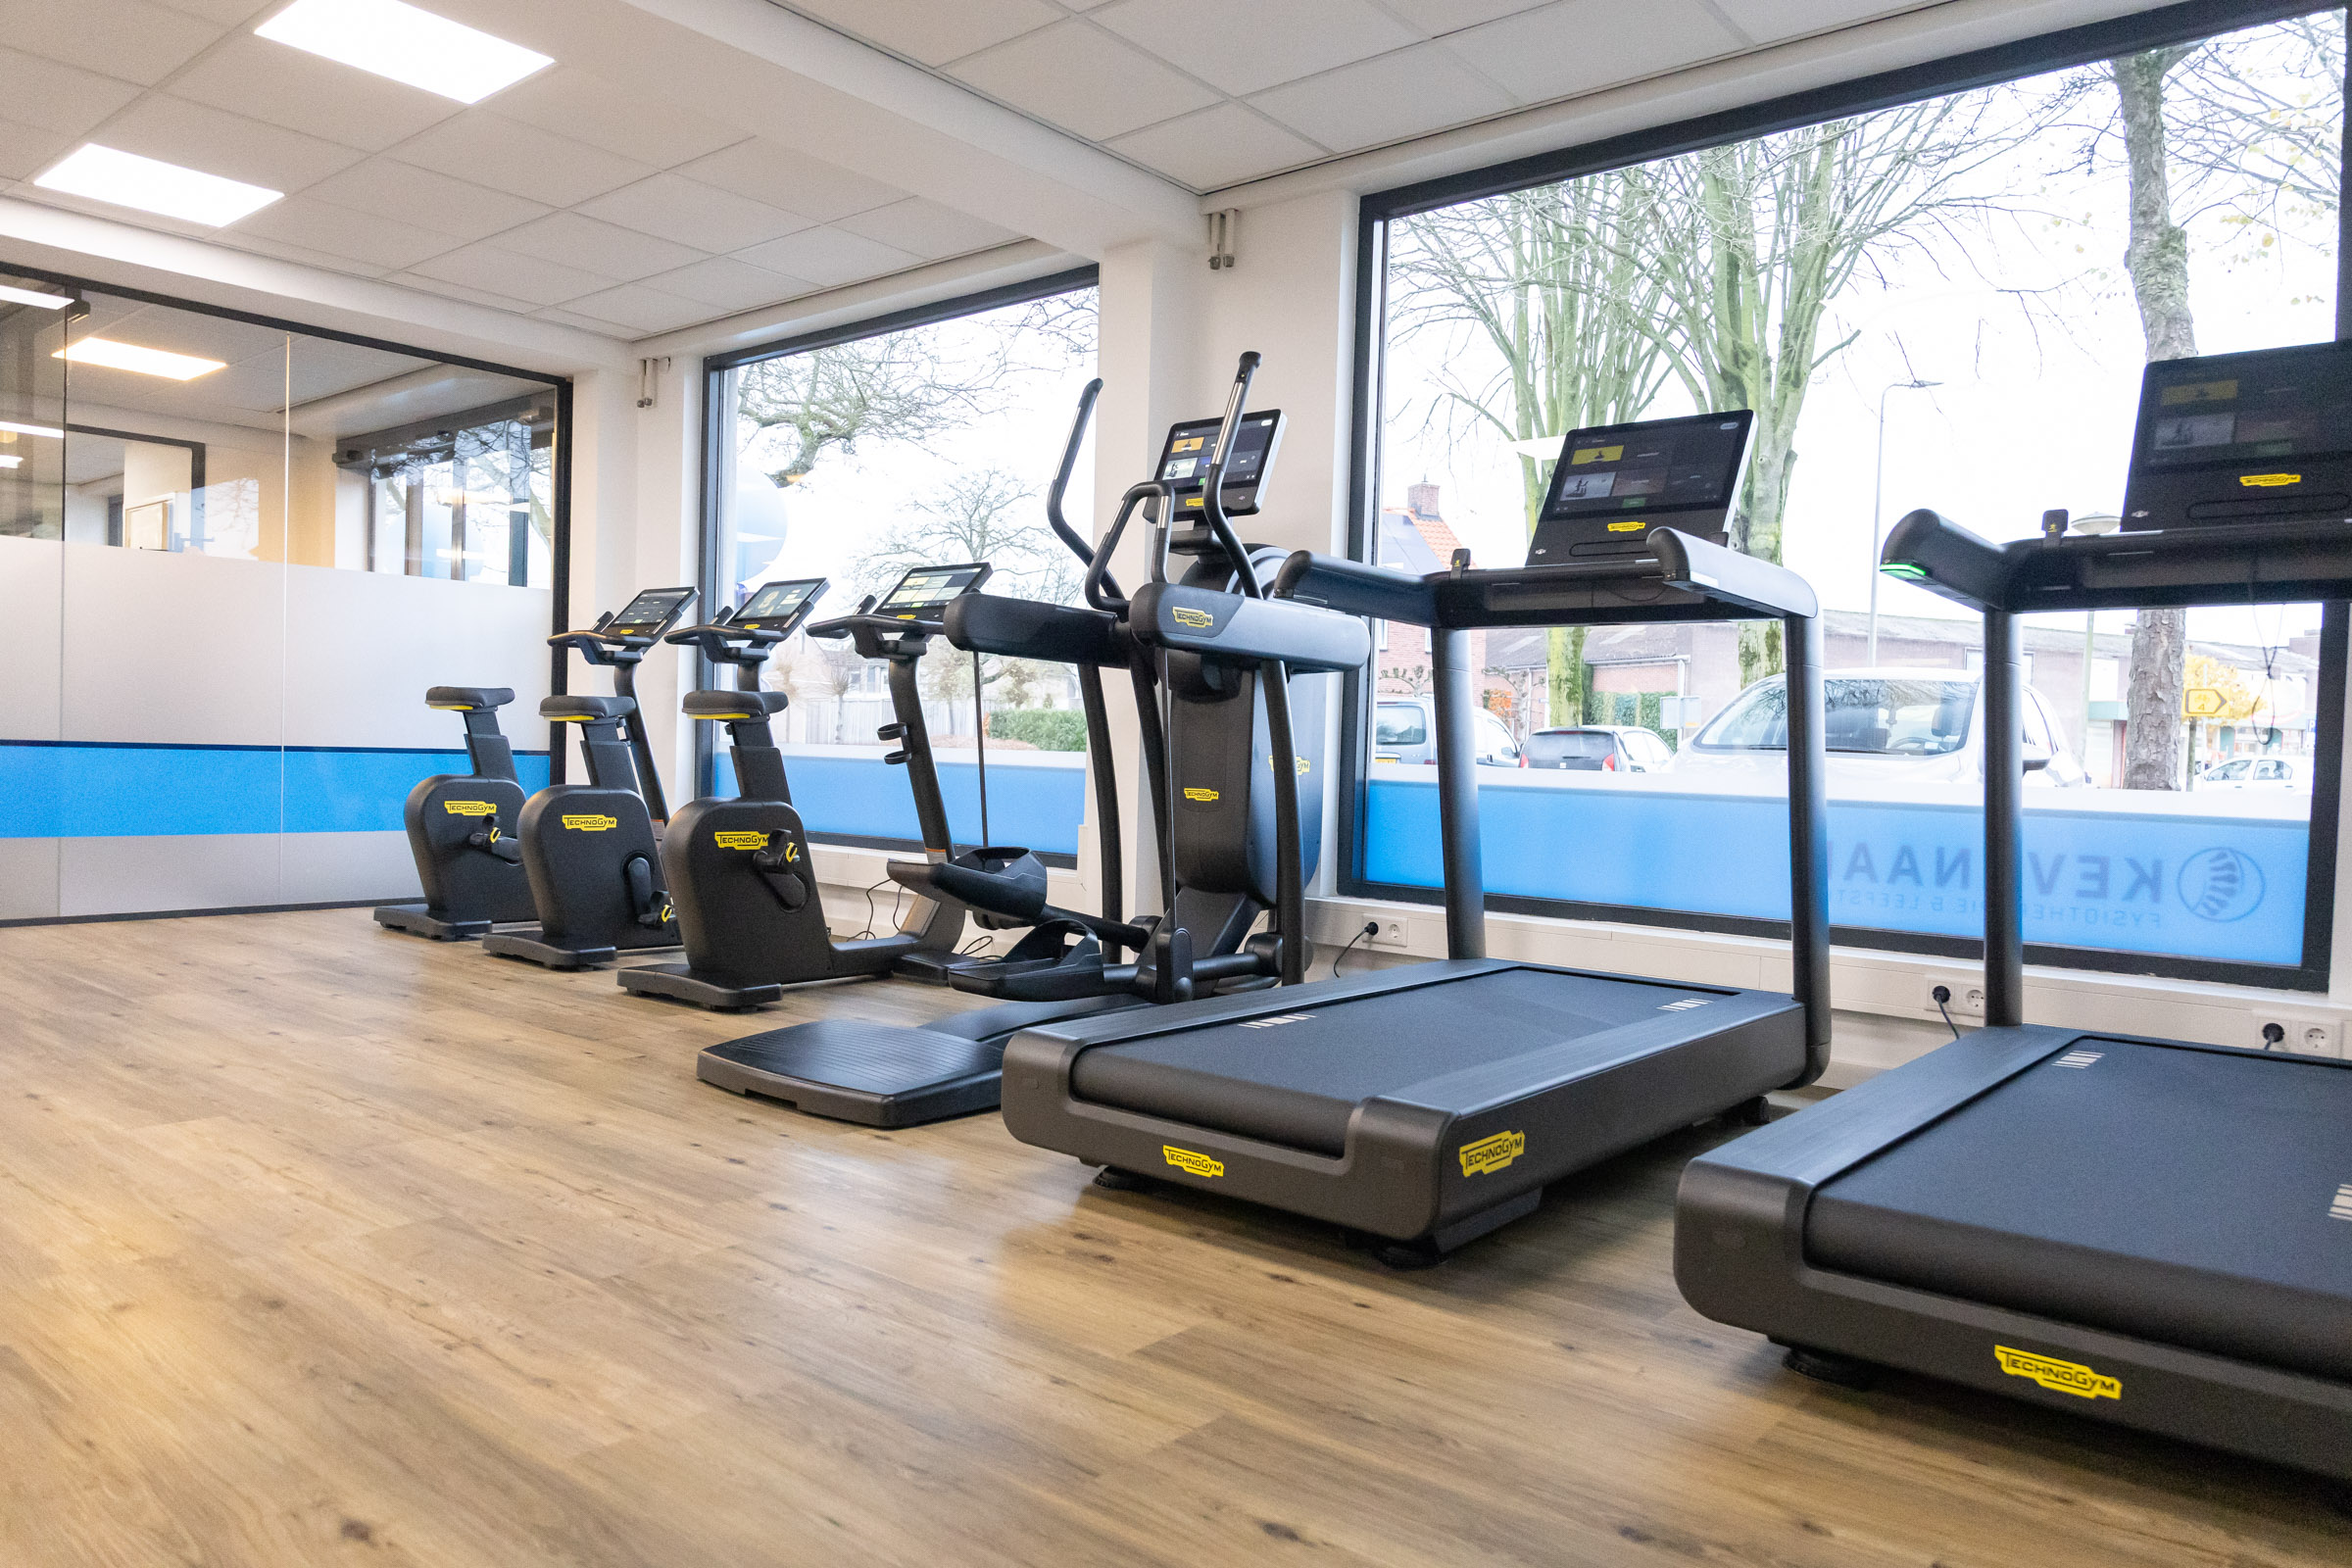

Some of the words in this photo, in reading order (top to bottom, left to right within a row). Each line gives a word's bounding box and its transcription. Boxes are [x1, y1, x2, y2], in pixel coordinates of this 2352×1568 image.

[445, 802, 496, 813] TECHNOGYM
[563, 816, 615, 828] TECHNOGYM
[1164, 1148, 1222, 1174] TECHNOGYM
[1461, 1136, 1523, 1170] TECHNOGYM
[1996, 1348, 2117, 1393] TECHNOGYM
